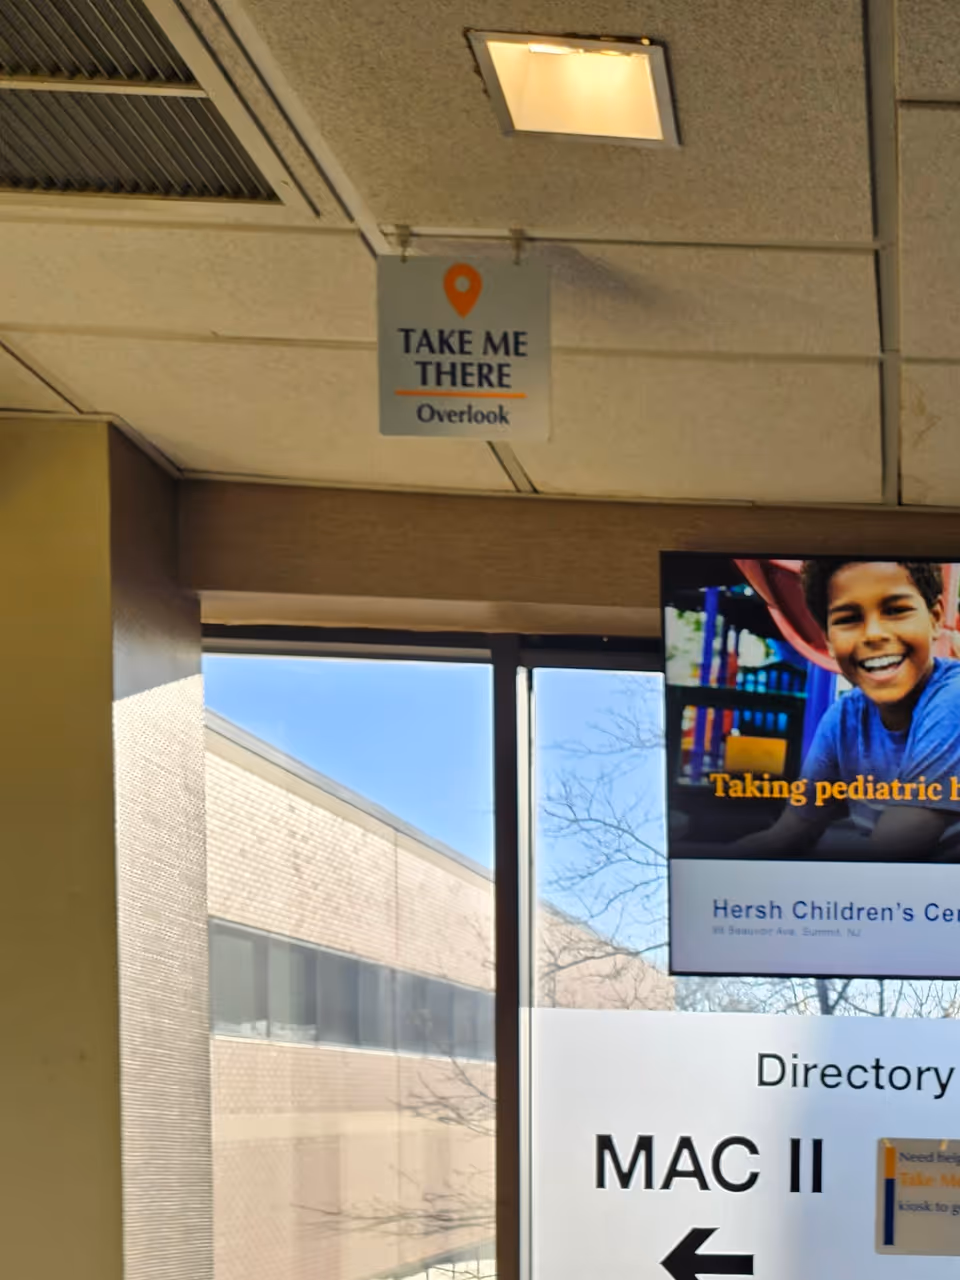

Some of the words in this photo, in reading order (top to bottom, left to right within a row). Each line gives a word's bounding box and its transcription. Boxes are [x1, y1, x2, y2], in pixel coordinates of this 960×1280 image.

[398, 328, 473, 355] TAKE
[483, 331, 528, 357] ME
[415, 361, 512, 388] THERE
[417, 402, 510, 425] Overlook
[709, 772, 808, 806] Taking
[815, 774, 943, 806] pediatric
[712, 898, 783, 920] Hersh
[792, 900, 914, 922] Children's
[757, 1054, 955, 1099] Directory
[595, 1134, 761, 1193] MAC
[790, 1138, 823, 1194] II
[899, 1152, 934, 1164] Need
[899, 1171, 934, 1188] Take
[898, 1200, 931, 1213] kiosk
[935, 1202, 949, 1213] to
